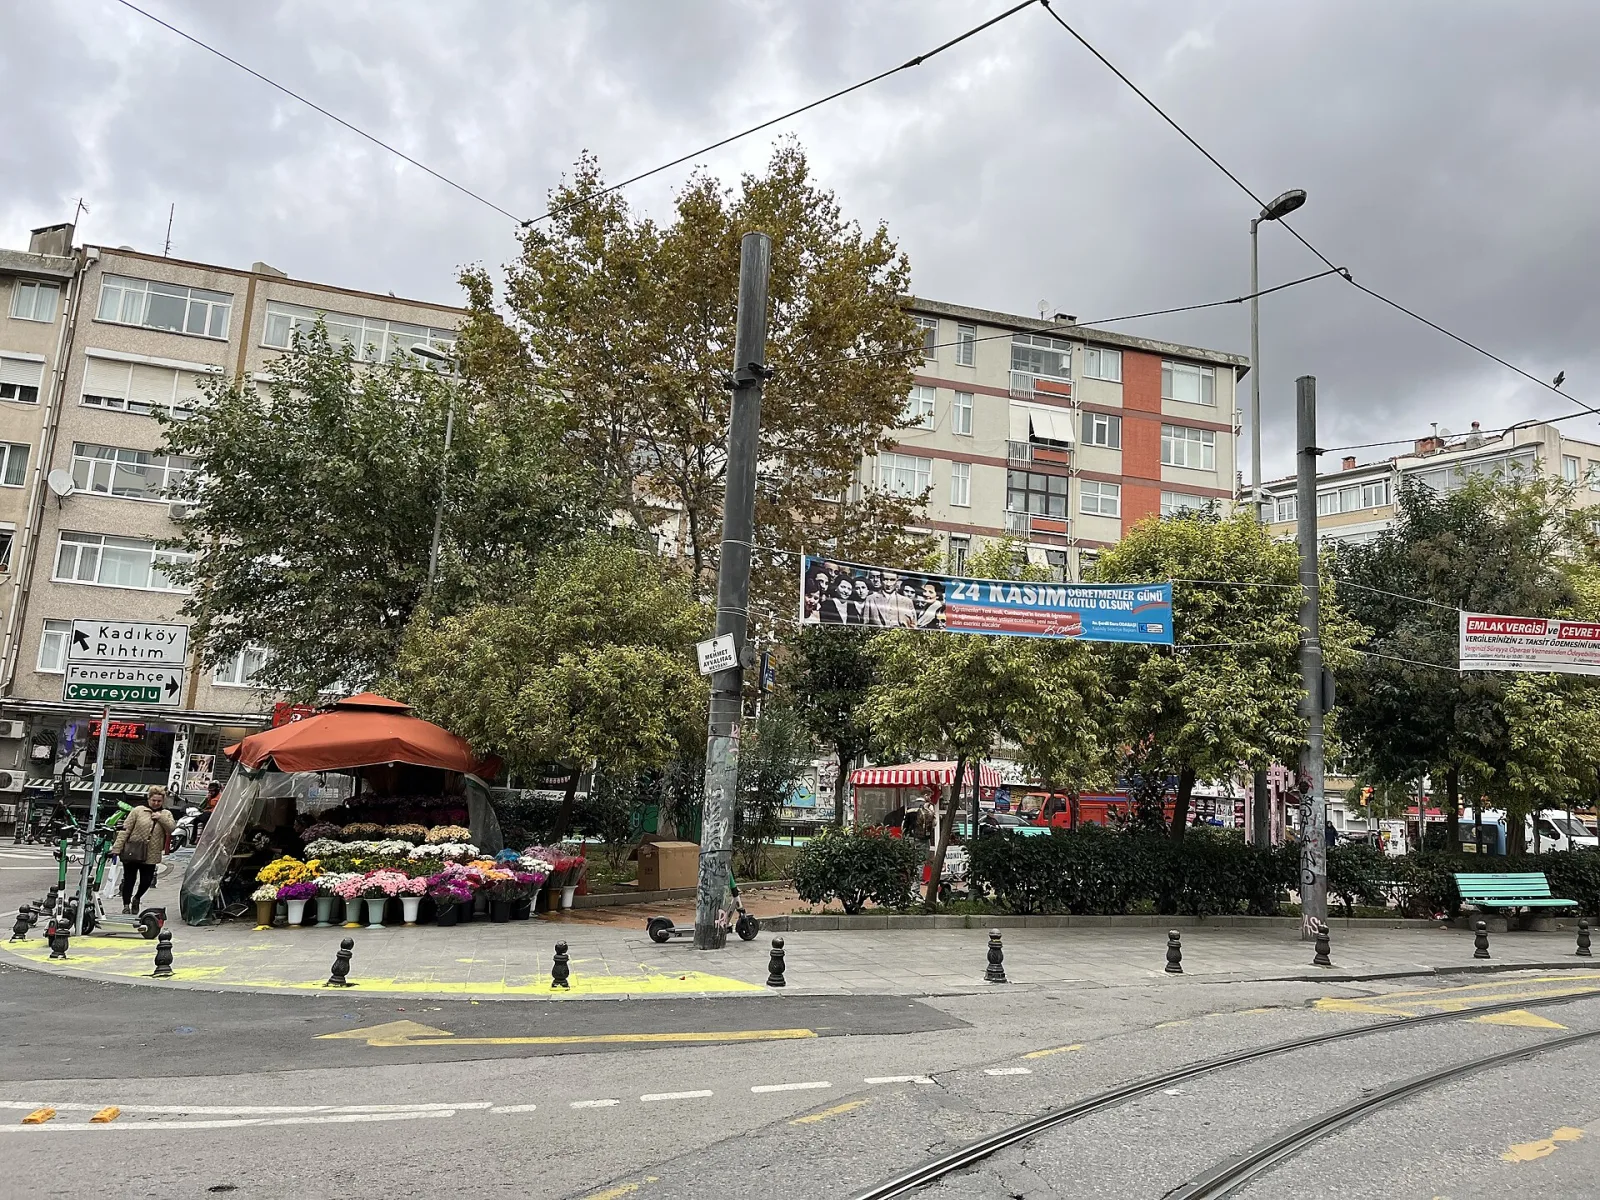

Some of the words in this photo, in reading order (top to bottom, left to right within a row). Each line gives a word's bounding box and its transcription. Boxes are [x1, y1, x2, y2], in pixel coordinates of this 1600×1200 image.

[951, 581, 980, 601] 24
[989, 583, 1066, 607] KASIM
[1137, 590, 1163, 602] GÜNÜ
[1067, 597, 1096, 608] KUTLU
[1099, 599, 1133, 611] OLSUN!
[99, 626, 177, 645] Kadıköy
[1468, 620, 1505, 632] EMLAK
[1506, 622, 1545, 634] VERGİSİ
[1561, 626, 1593, 638] ÇEVRE
[1465, 634, 1518, 644] VERGİLERİNİZİN
[1525, 637, 1550, 646] TAKSİT
[1550, 638, 1588, 649] ÖDEMESİNİ
[97, 643, 163, 658] Rıhtım
[705, 649, 728, 660] MEHMET
[703, 654, 732, 667] AYVALITAŞ
[70, 667, 164, 683] Fenerbahçe
[68, 684, 158, 701] Çevreyolu
